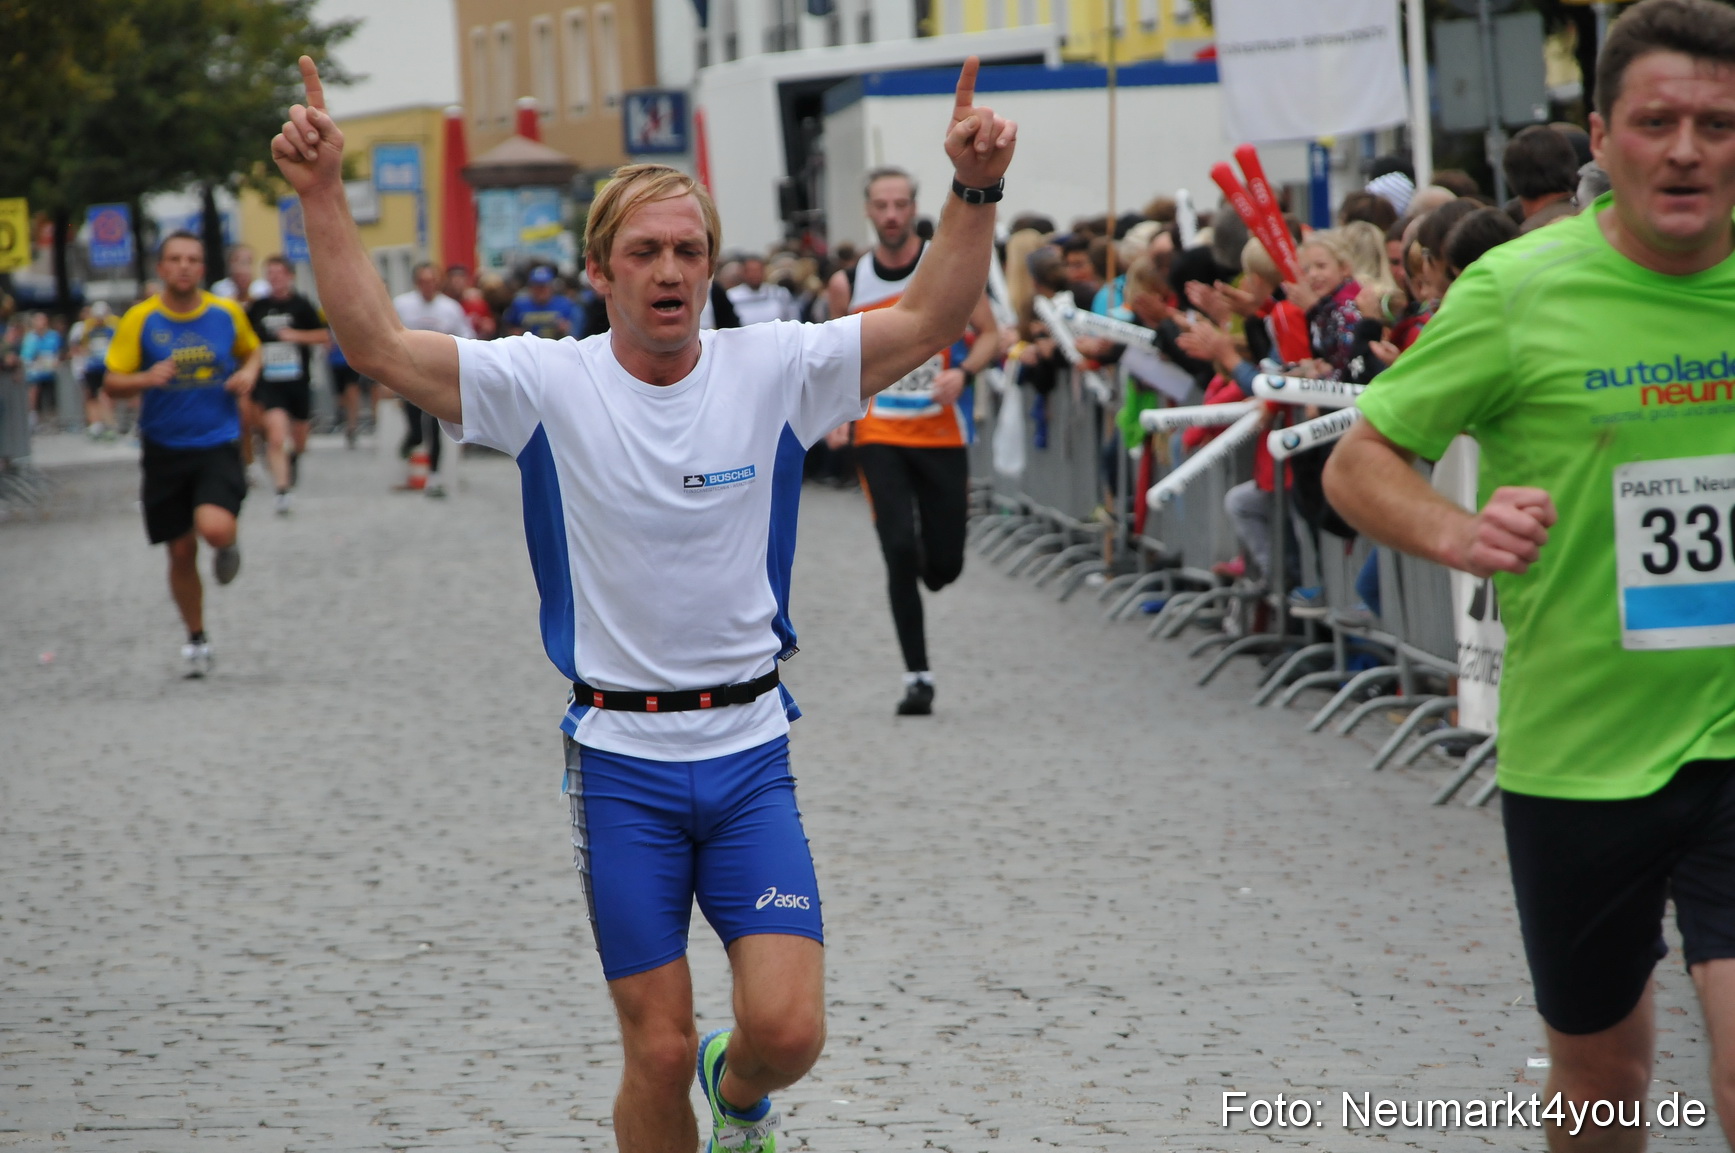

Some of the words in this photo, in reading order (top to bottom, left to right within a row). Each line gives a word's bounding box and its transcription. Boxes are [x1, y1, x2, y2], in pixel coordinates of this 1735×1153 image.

[1620, 478, 1690, 498] PARTL
[1641, 504, 1735, 575] 33
[774, 893, 810, 910] asics
